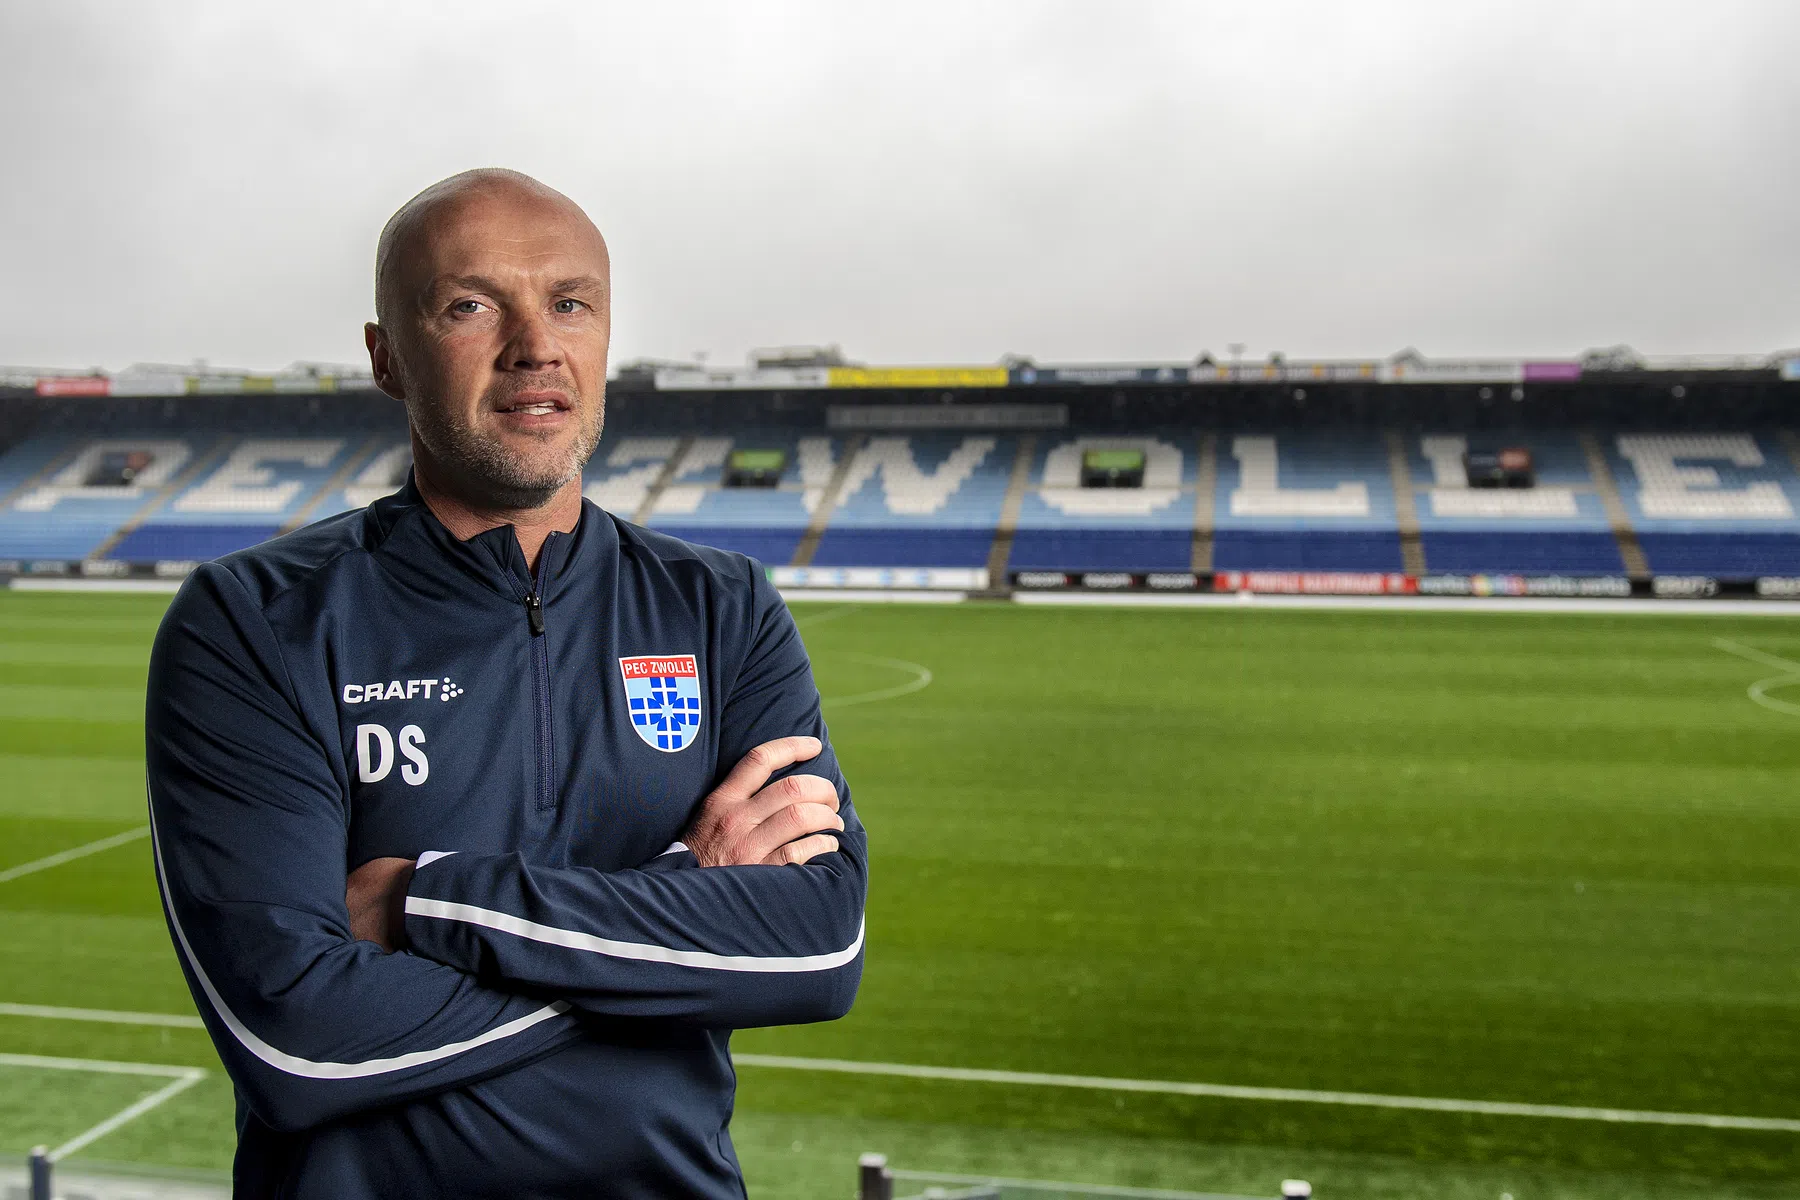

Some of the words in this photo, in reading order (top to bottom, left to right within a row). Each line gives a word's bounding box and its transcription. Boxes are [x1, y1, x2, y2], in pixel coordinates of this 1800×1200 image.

[583, 434, 1794, 519] ZWOLLE
[624, 661, 648, 675] PEC
[650, 660, 694, 674] ZWOLLE
[343, 679, 438, 704] CRAFT
[356, 723, 430, 786] DS
